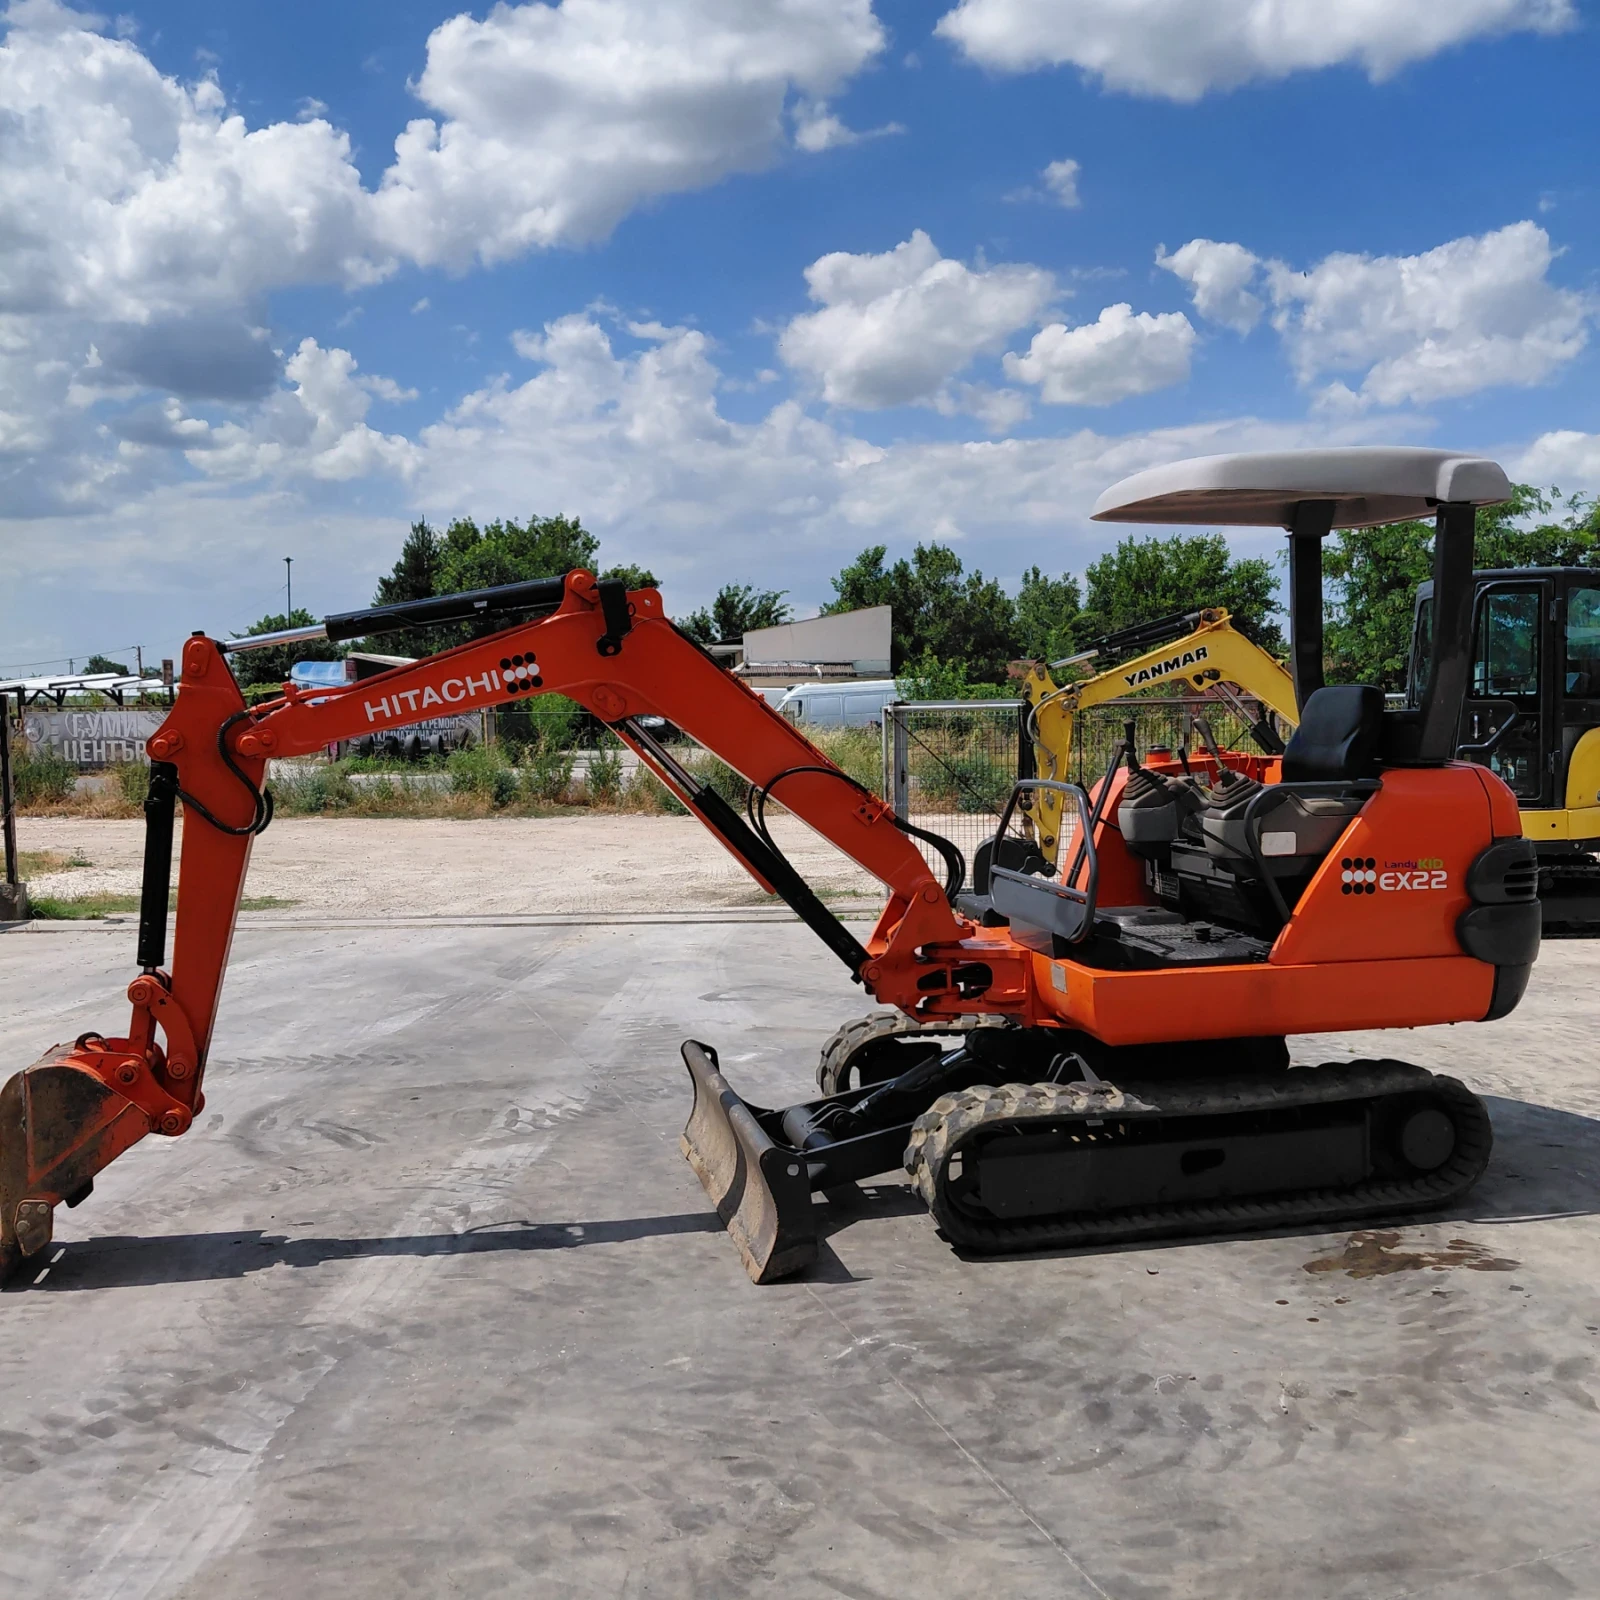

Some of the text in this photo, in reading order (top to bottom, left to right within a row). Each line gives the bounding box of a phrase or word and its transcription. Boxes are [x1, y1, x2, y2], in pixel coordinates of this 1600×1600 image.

[1124, 646, 1208, 687] YANMAR
[364, 670, 501, 722] HITACHI
[72, 713, 138, 738] ГУМИ
[1379, 870, 1448, 891] EX22
